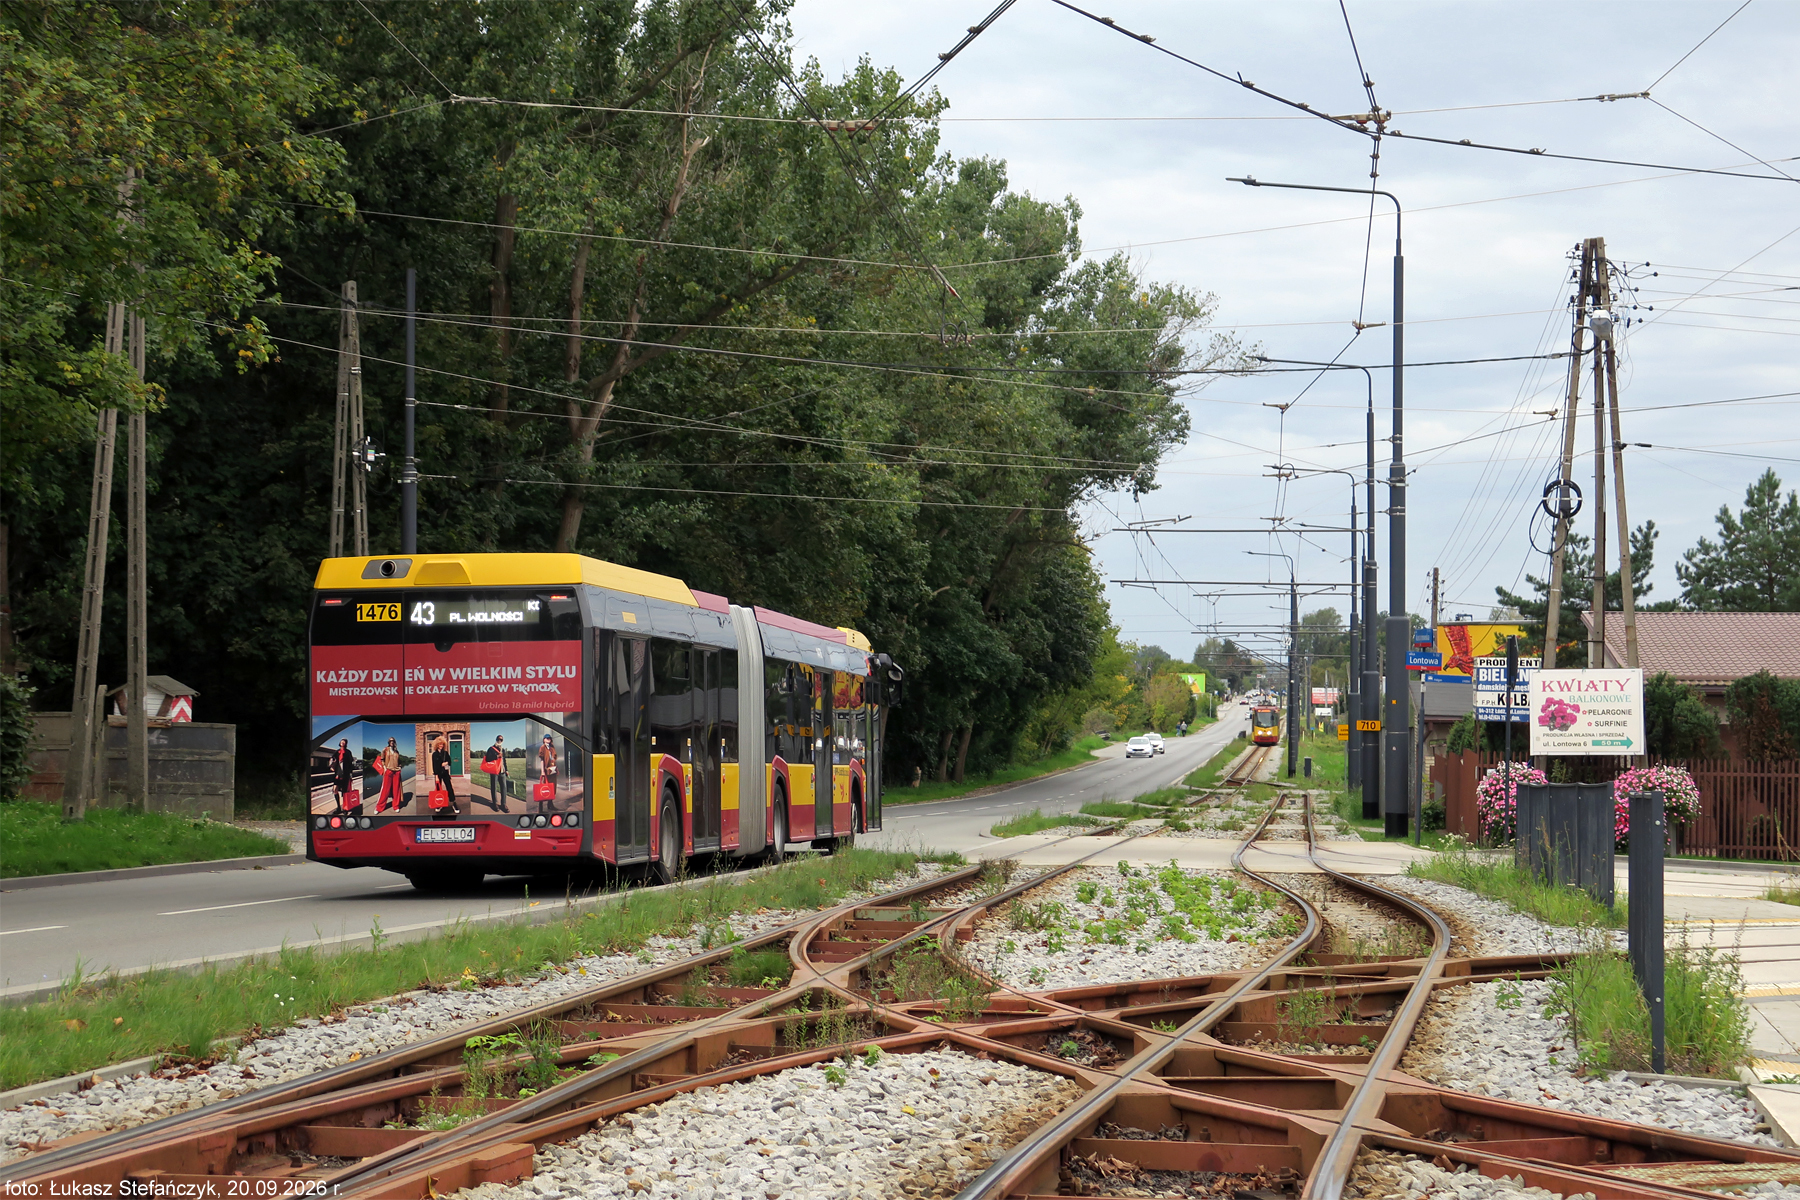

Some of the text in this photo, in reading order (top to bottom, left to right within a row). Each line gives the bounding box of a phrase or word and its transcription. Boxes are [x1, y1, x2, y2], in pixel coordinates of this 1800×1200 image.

[356, 604, 398, 620] 1476
[411, 601, 435, 625] 43
[449, 610, 523, 623] PL. WOLNOŚCI
[1409, 656, 1439, 665] Lontowa
[1479, 659, 1539, 667] PRODENT
[316, 667, 368, 683] KAŻDY
[429, 668, 446, 681] W
[449, 666, 522, 680] WIELKIM
[525, 665, 577, 679] STYLU
[329, 686, 414, 696] MISTRZOWSKIE
[416, 685, 459, 695] OKAZJE
[461, 684, 496, 693] TYLKO
[497, 684, 509, 693] W
[1541, 678, 1631, 692] KWIATY
[1569, 694, 1632, 703] BALKONOWE
[479, 701, 575, 710] Urbino 18 mild hybrid
[1588, 708, 1632, 716] PELARGONIE
[1361, 721, 1376, 730] 710
[423, 828, 473, 840] EL 5LL04
